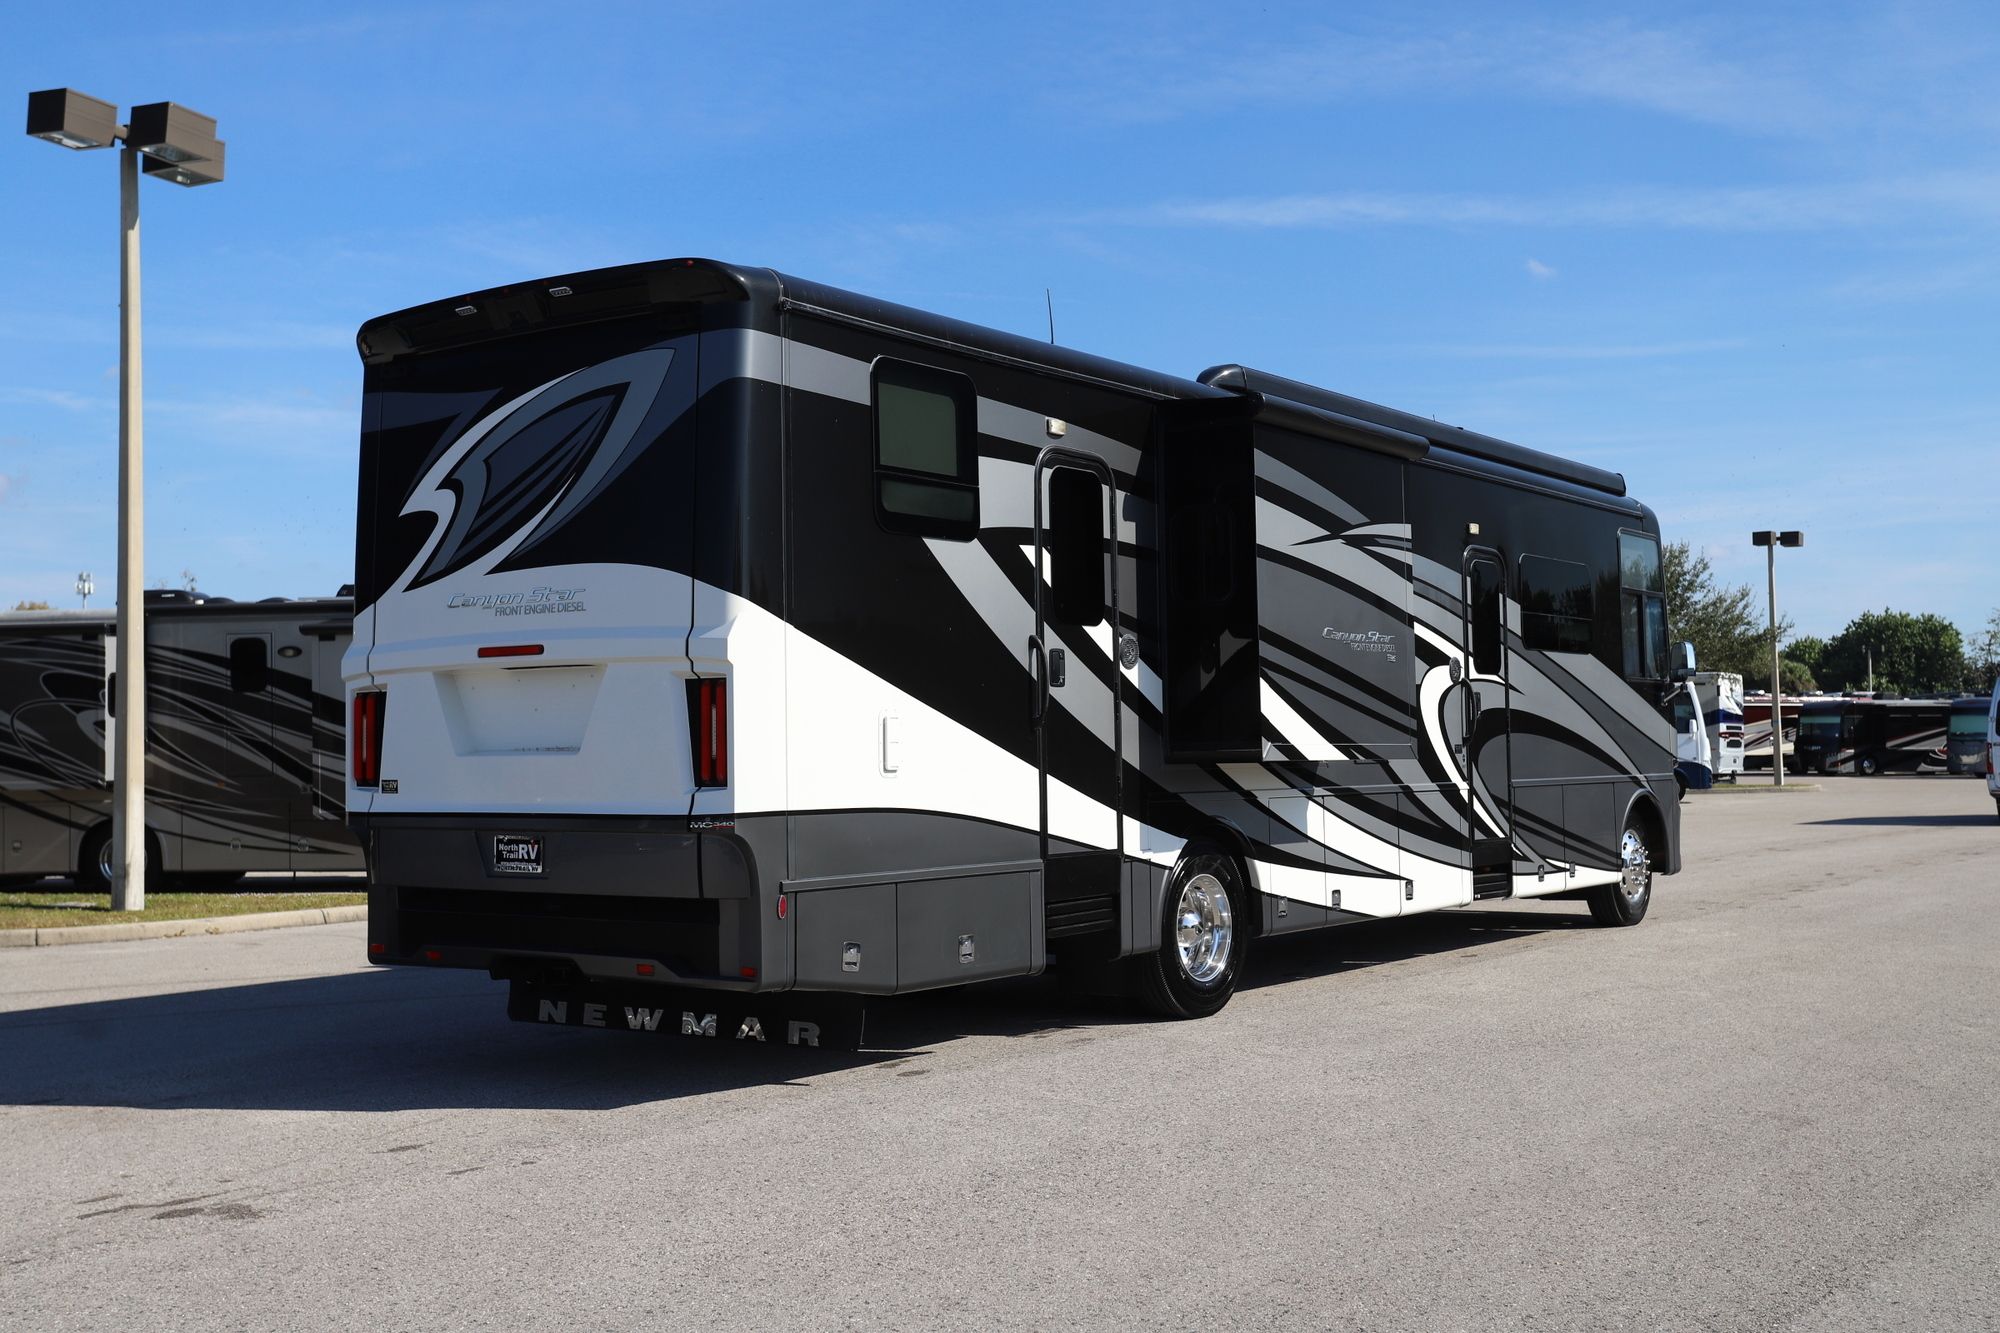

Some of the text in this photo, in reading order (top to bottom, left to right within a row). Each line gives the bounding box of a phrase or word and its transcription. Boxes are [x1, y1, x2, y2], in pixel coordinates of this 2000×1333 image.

[447, 586, 586, 609] Canyon Star
[495, 601, 587, 617] FRONT ENGINE DIESEL
[1322, 627, 1396, 643] Canyon Star
[502, 851, 518, 859] Trail
[519, 844, 538, 860] RV
[538, 999, 821, 1047] NEWMAR
